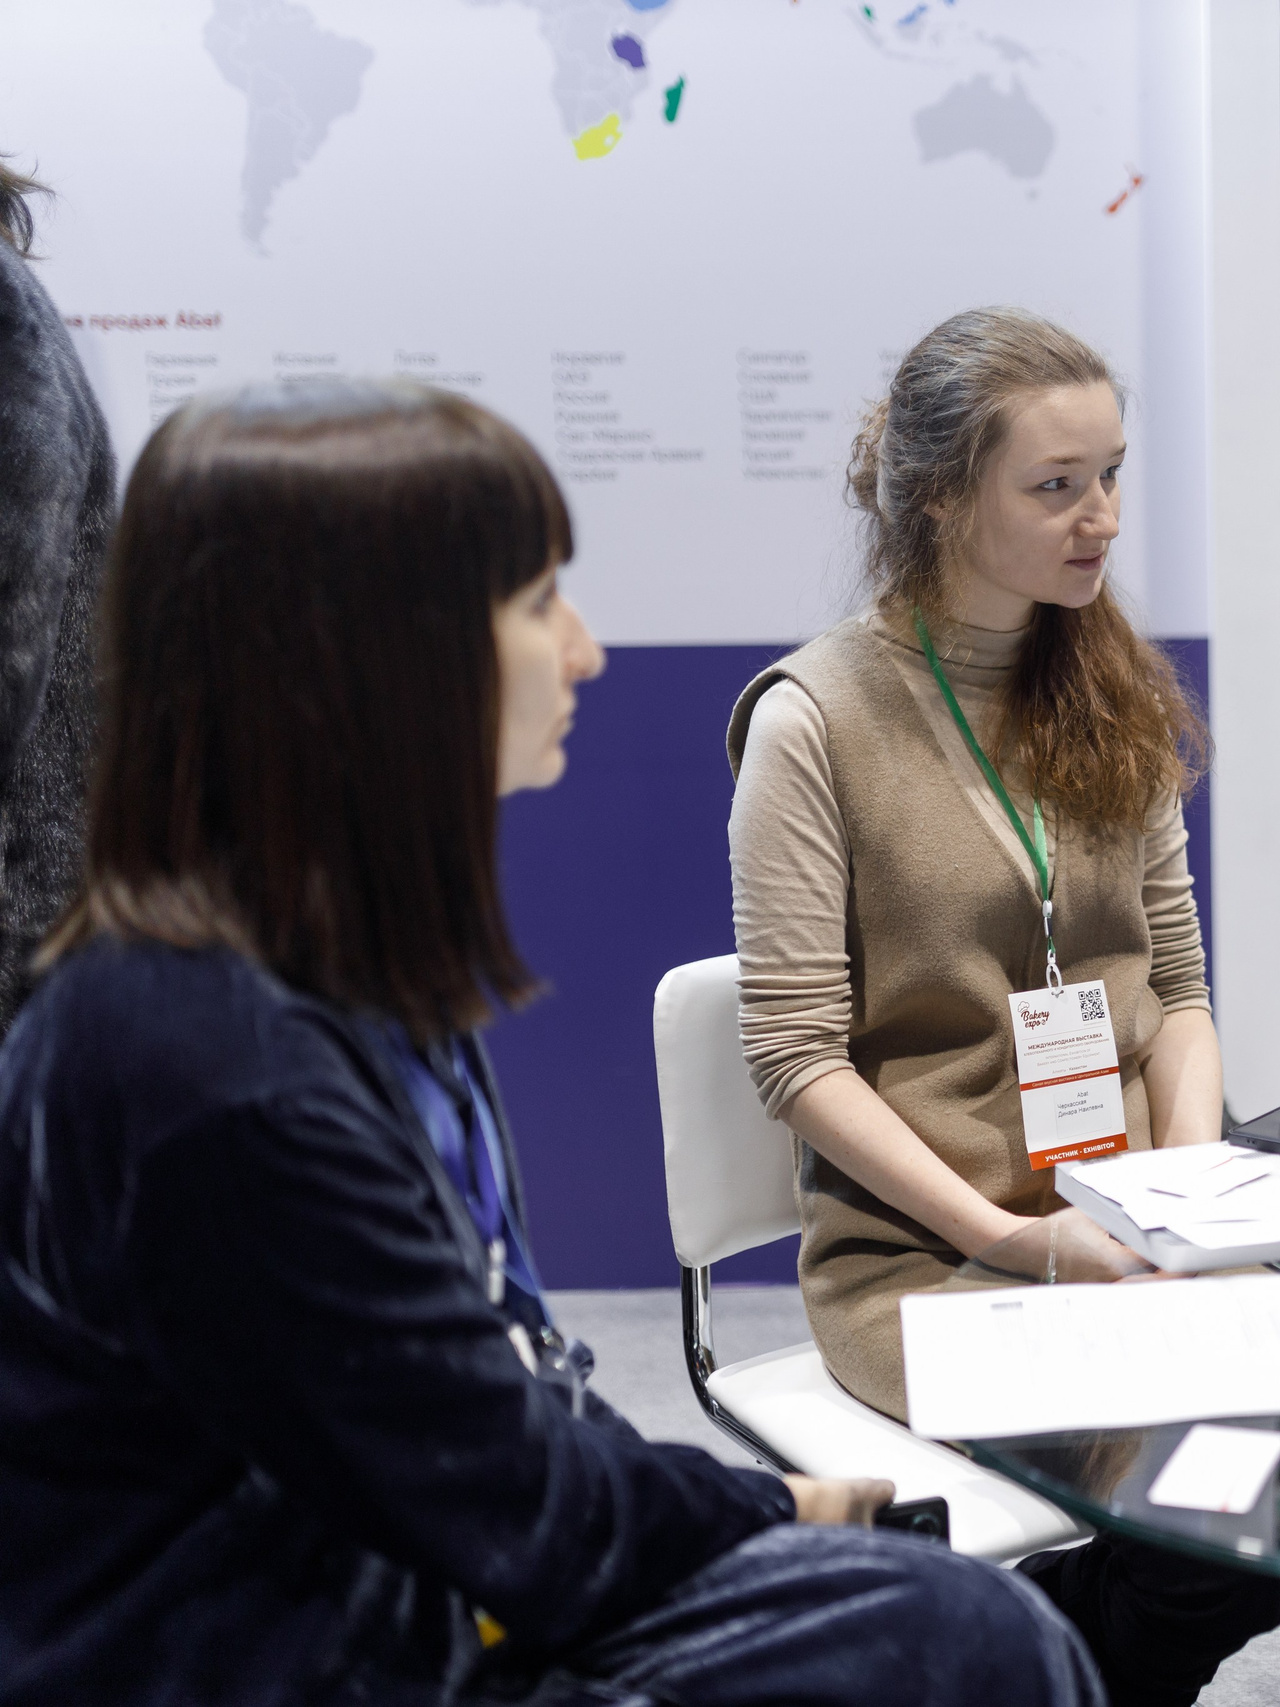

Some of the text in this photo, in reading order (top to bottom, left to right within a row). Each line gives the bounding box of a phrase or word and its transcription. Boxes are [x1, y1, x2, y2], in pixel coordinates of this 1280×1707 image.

[89, 314, 168, 333] продаж
[176, 310, 222, 330] Abat
[1021, 1010, 1050, 1021] Bakery
[1025, 1020, 1041, 1030] expo
[1028, 1033, 1103, 1050] МЕЖДУНАРОДНАЯ ВЫСТАВКА
[1057, 1100, 1087, 1109] Черкасская
[1058, 1104, 1104, 1118] Динара Наилевна
[1045, 1150, 1079, 1162] УЧАСТНИК
[1083, 1141, 1115, 1154] EXHIBITOR
